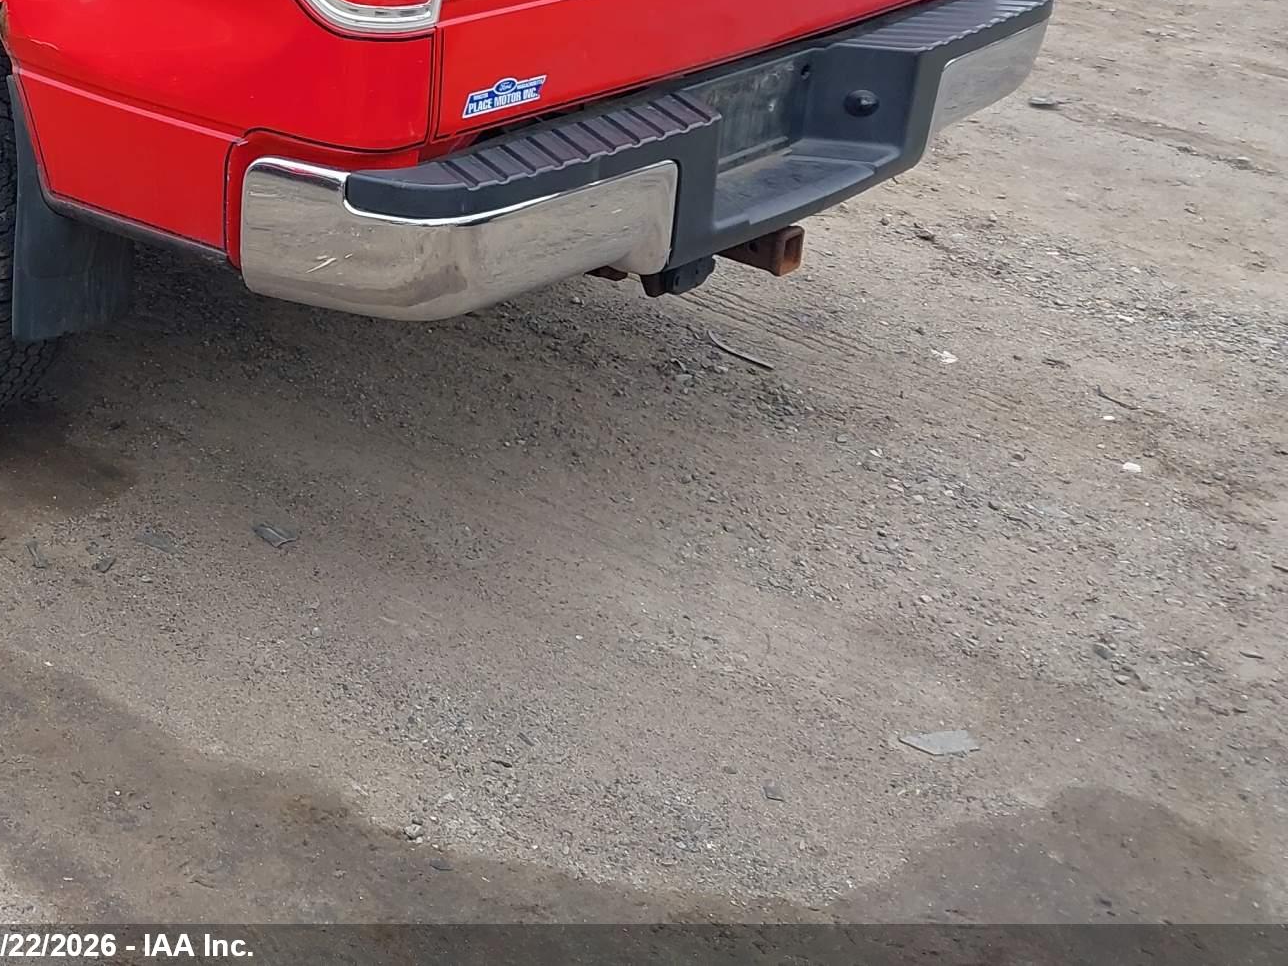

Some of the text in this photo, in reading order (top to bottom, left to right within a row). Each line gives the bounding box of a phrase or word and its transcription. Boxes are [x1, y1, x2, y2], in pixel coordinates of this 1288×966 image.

[467, 97, 493, 115] PLACE
[493, 90, 522, 108] MOTOR
[522, 86, 539, 101] INC.
